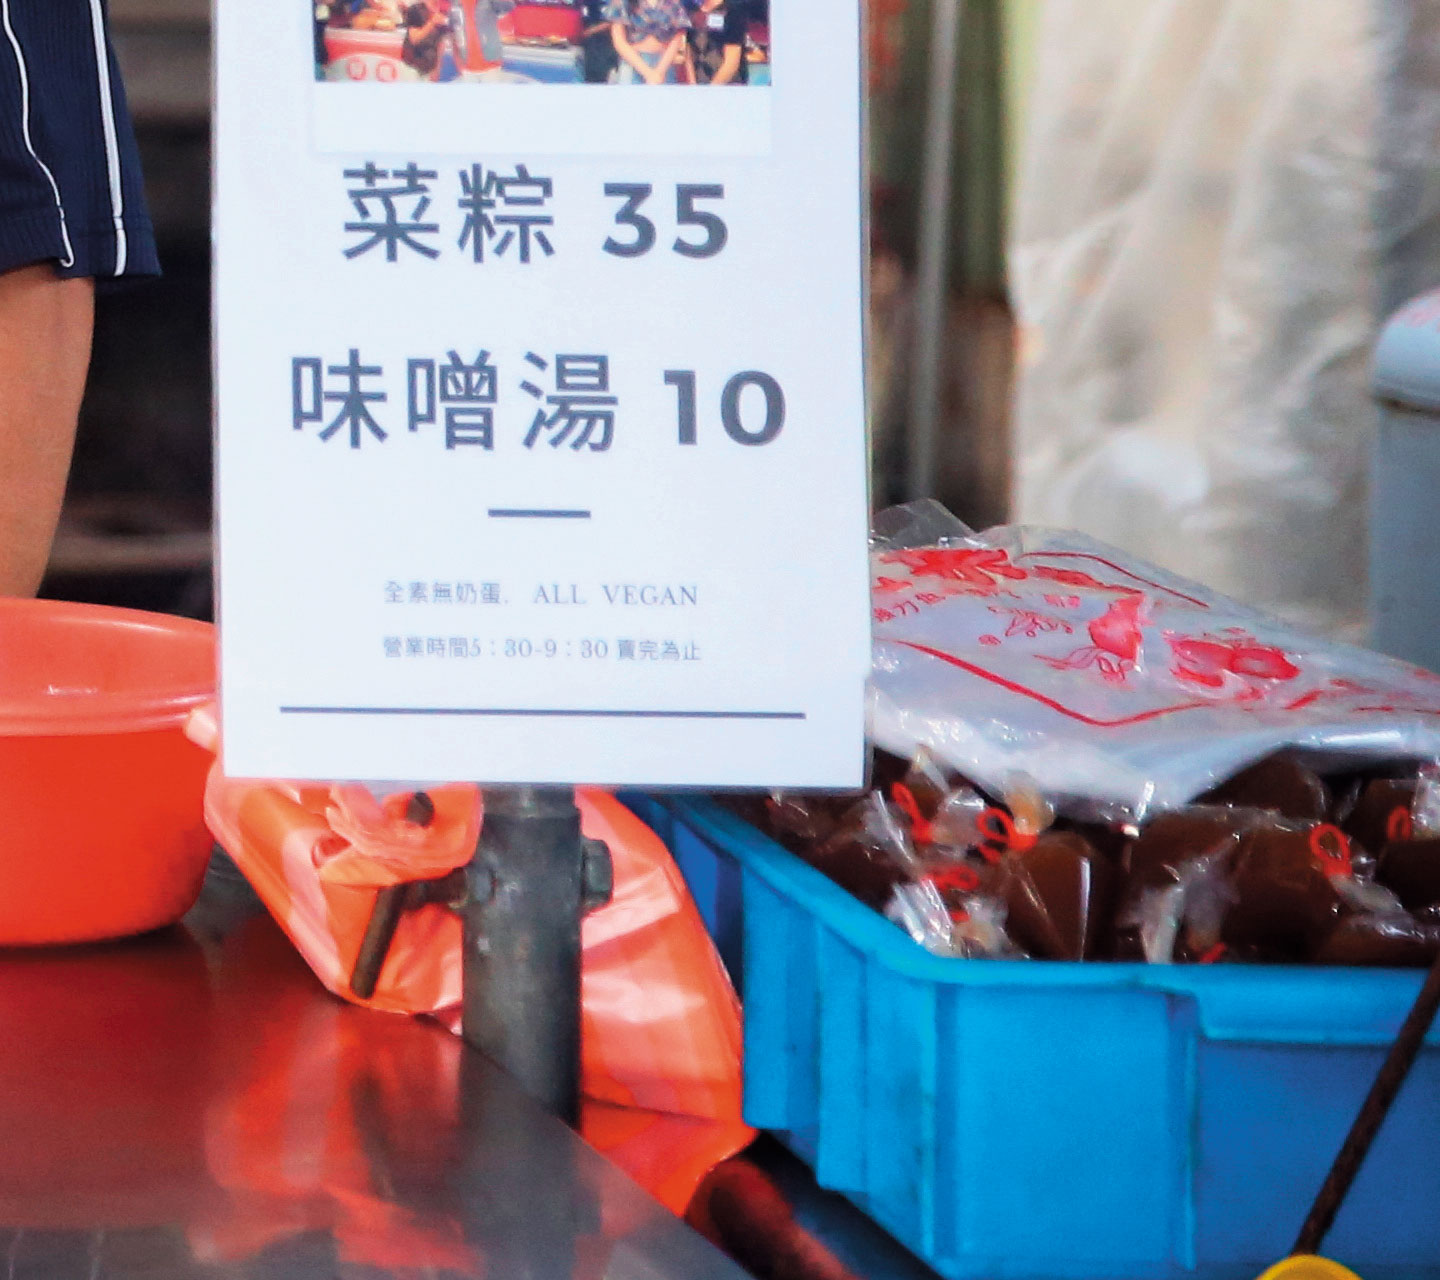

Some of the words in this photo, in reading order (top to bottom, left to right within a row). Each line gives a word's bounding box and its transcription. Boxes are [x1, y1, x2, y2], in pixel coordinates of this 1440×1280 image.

[341, 161, 557, 265] 菜粽
[601, 182, 729, 260] 35
[291, 347, 619, 453] 味噌湯
[663, 369, 787, 447] 10
[533, 584, 587, 606] ALL
[601, 584, 698, 607] VEGAN
